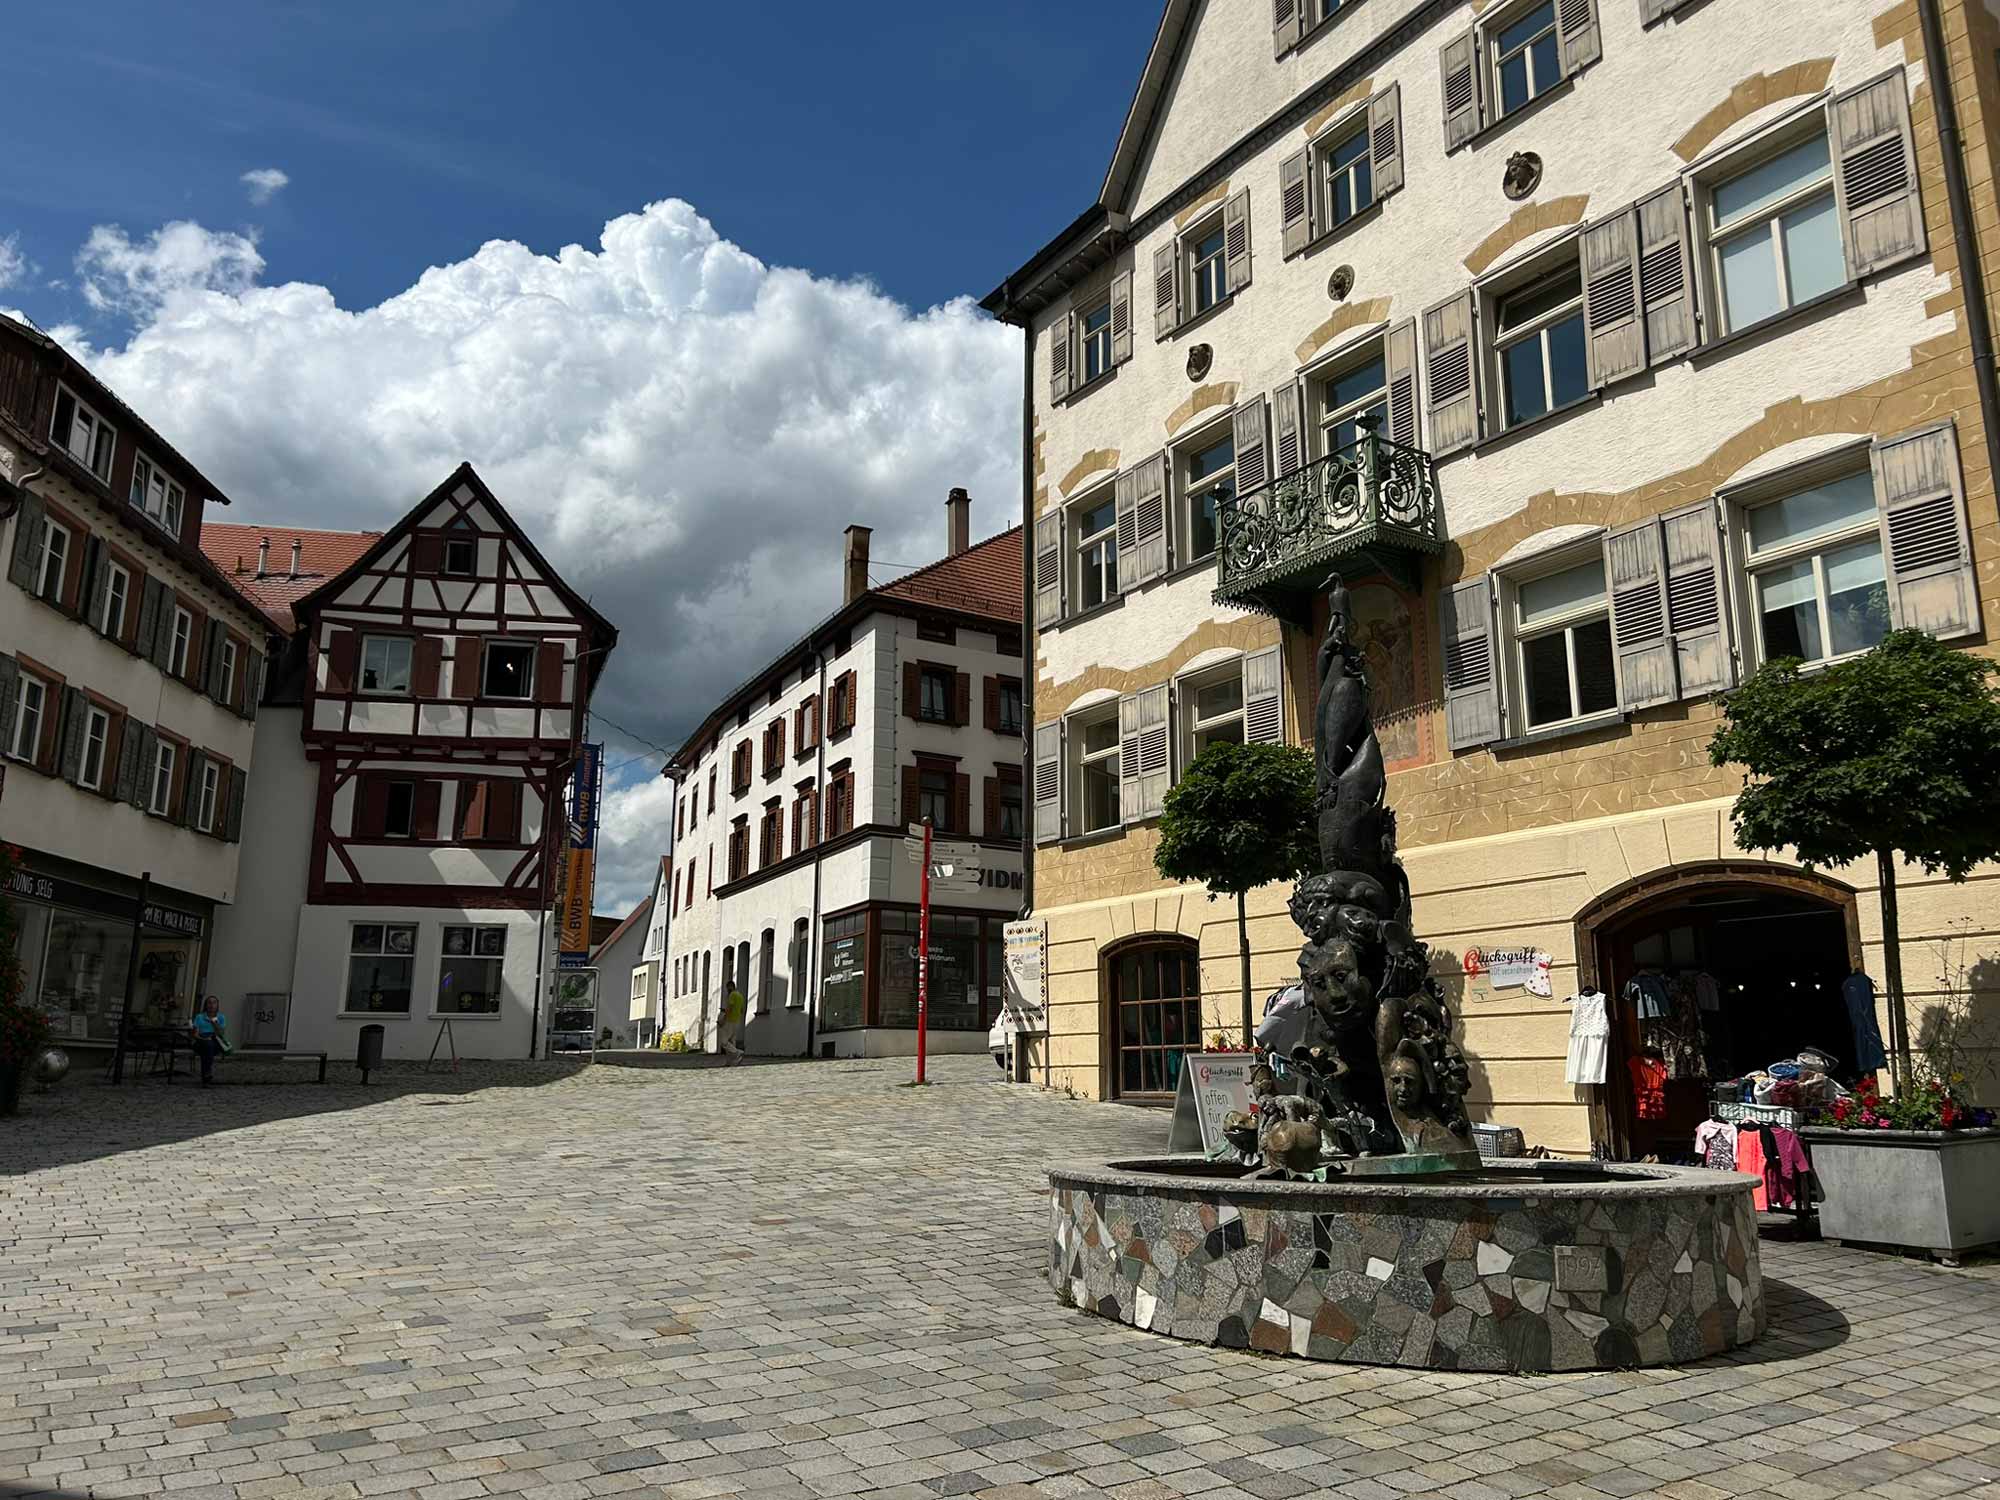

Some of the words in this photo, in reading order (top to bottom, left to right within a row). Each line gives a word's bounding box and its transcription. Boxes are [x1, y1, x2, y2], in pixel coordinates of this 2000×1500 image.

[569, 898, 583, 930] BWB
[1463, 946, 1537, 980] Glücksgriff
[1205, 1089, 1229, 1106] offen
[1208, 1108, 1221, 1124] für
[1560, 1255, 1600, 1281] 1997
